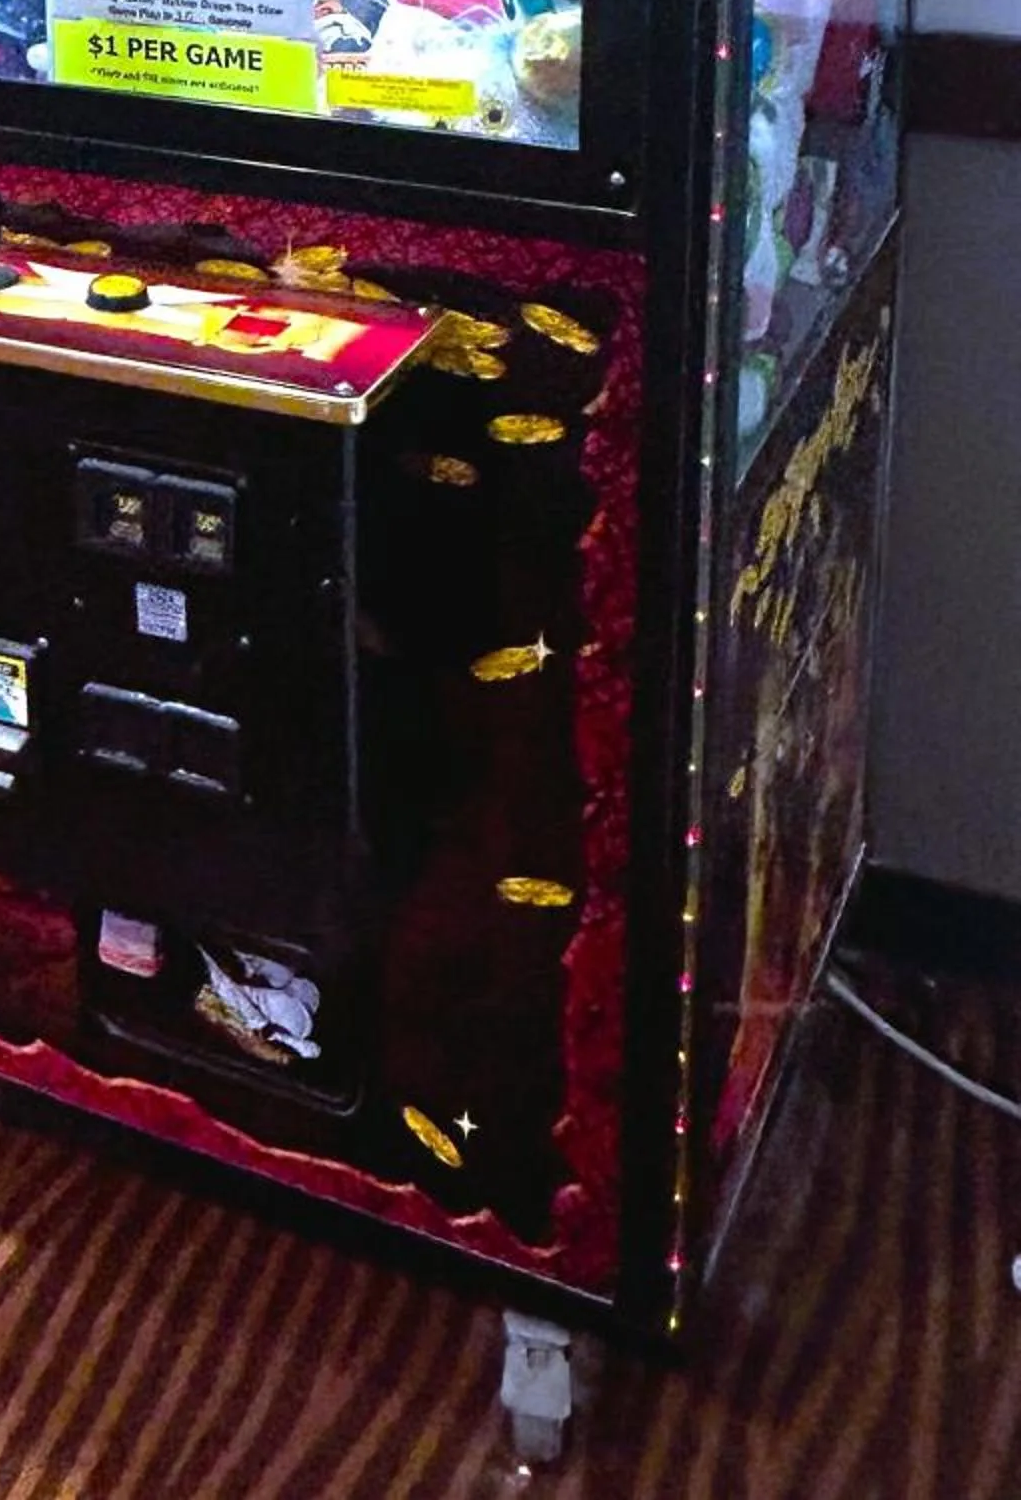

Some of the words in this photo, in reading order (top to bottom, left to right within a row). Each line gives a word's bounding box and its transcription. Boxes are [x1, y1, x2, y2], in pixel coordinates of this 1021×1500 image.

[87, 33, 118, 59] $1
[129, 38, 178, 62] PER
[186, 45, 263, 71] GAME
